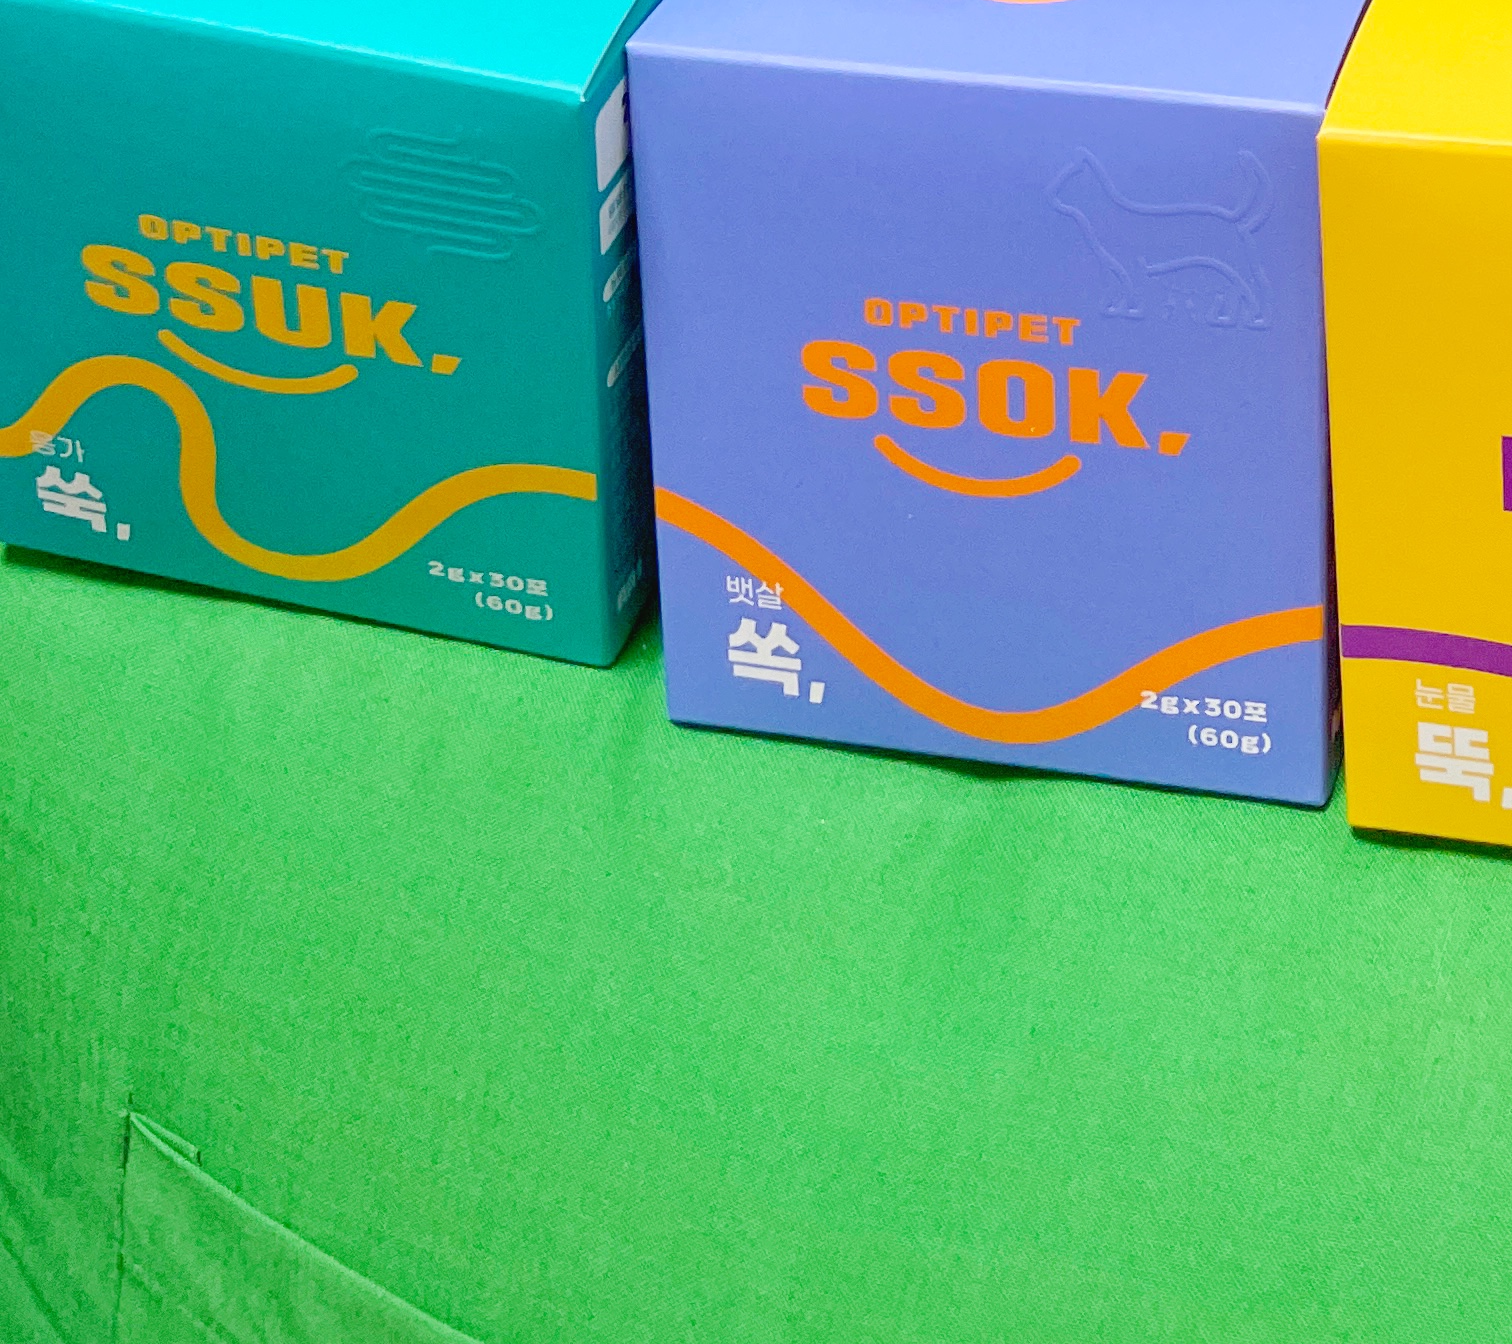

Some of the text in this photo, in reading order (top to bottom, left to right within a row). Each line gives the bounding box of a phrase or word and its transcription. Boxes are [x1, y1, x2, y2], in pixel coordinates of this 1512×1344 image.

[138, 214, 349, 274] OPTIPET
[863, 297, 1081, 346] OPTIPET
[475, 591, 553, 621] (60g)
[726, 575, 784, 611] 뱃살
[1415, 678, 1476, 714] 눈물
[1188, 724, 1272, 754] (60g)
